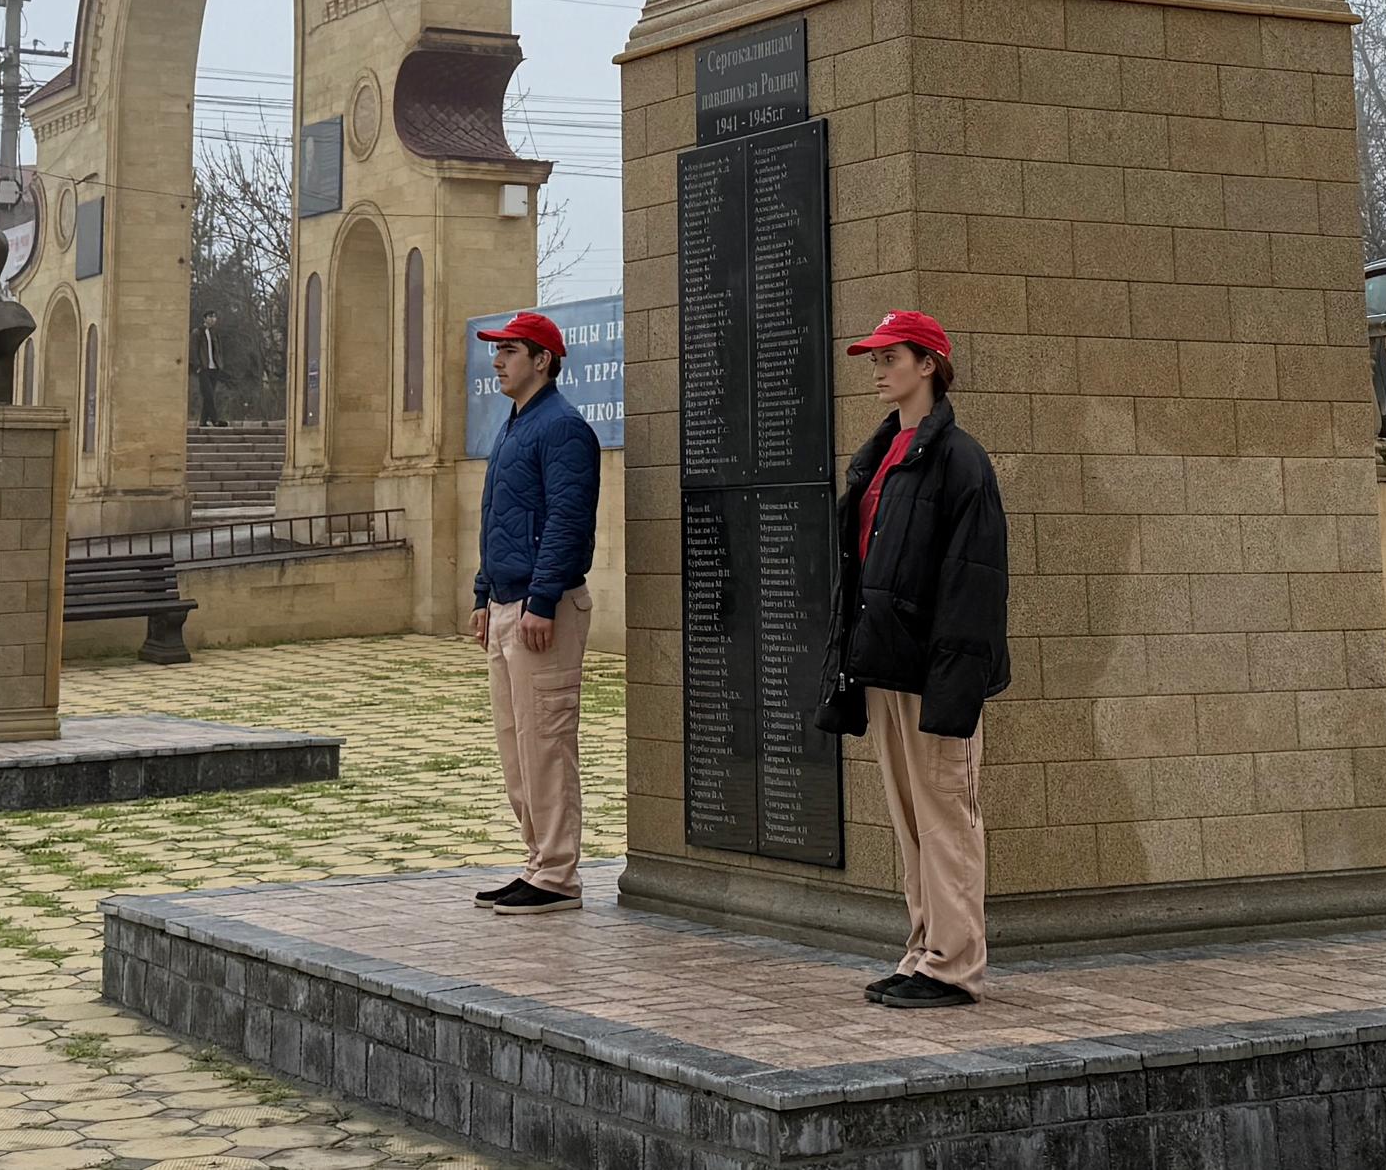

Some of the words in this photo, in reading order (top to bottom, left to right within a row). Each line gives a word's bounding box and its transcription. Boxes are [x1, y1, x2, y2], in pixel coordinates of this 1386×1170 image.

[707, 34, 793, 75] Сергокалинцам
[702, 85, 744, 110] павшим
[747, 81, 758, 99] за
[761, 70, 799, 94] Родину
[716, 115, 738, 135] 1941
